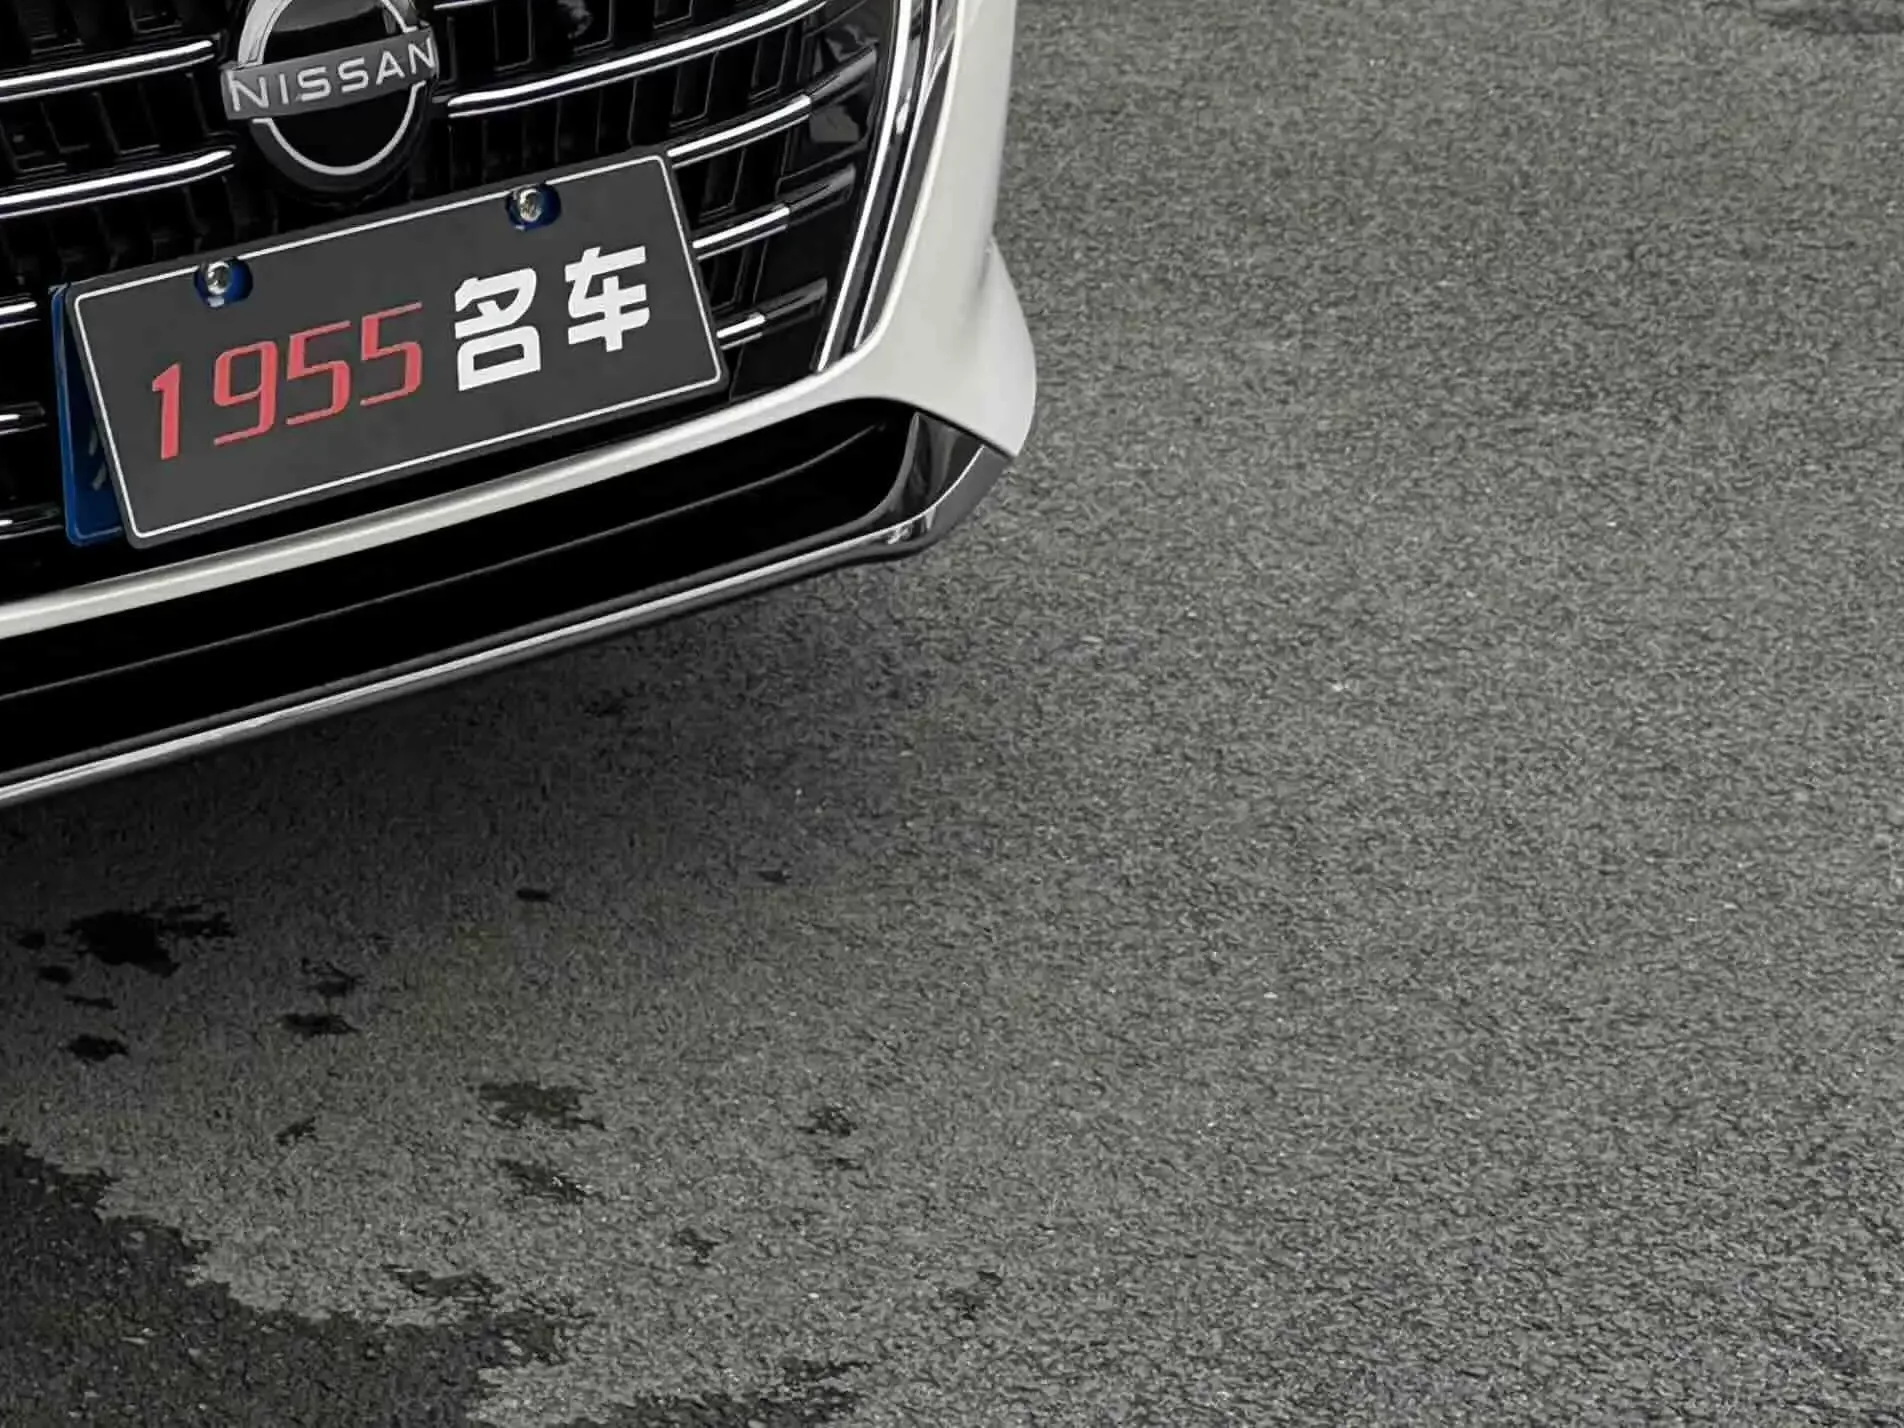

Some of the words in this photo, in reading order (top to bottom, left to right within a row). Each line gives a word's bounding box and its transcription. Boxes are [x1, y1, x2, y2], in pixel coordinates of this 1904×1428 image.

[226, 36, 436, 112] NISSAN
[151, 301, 424, 460] 1955
[454, 245, 650, 392] 名车
